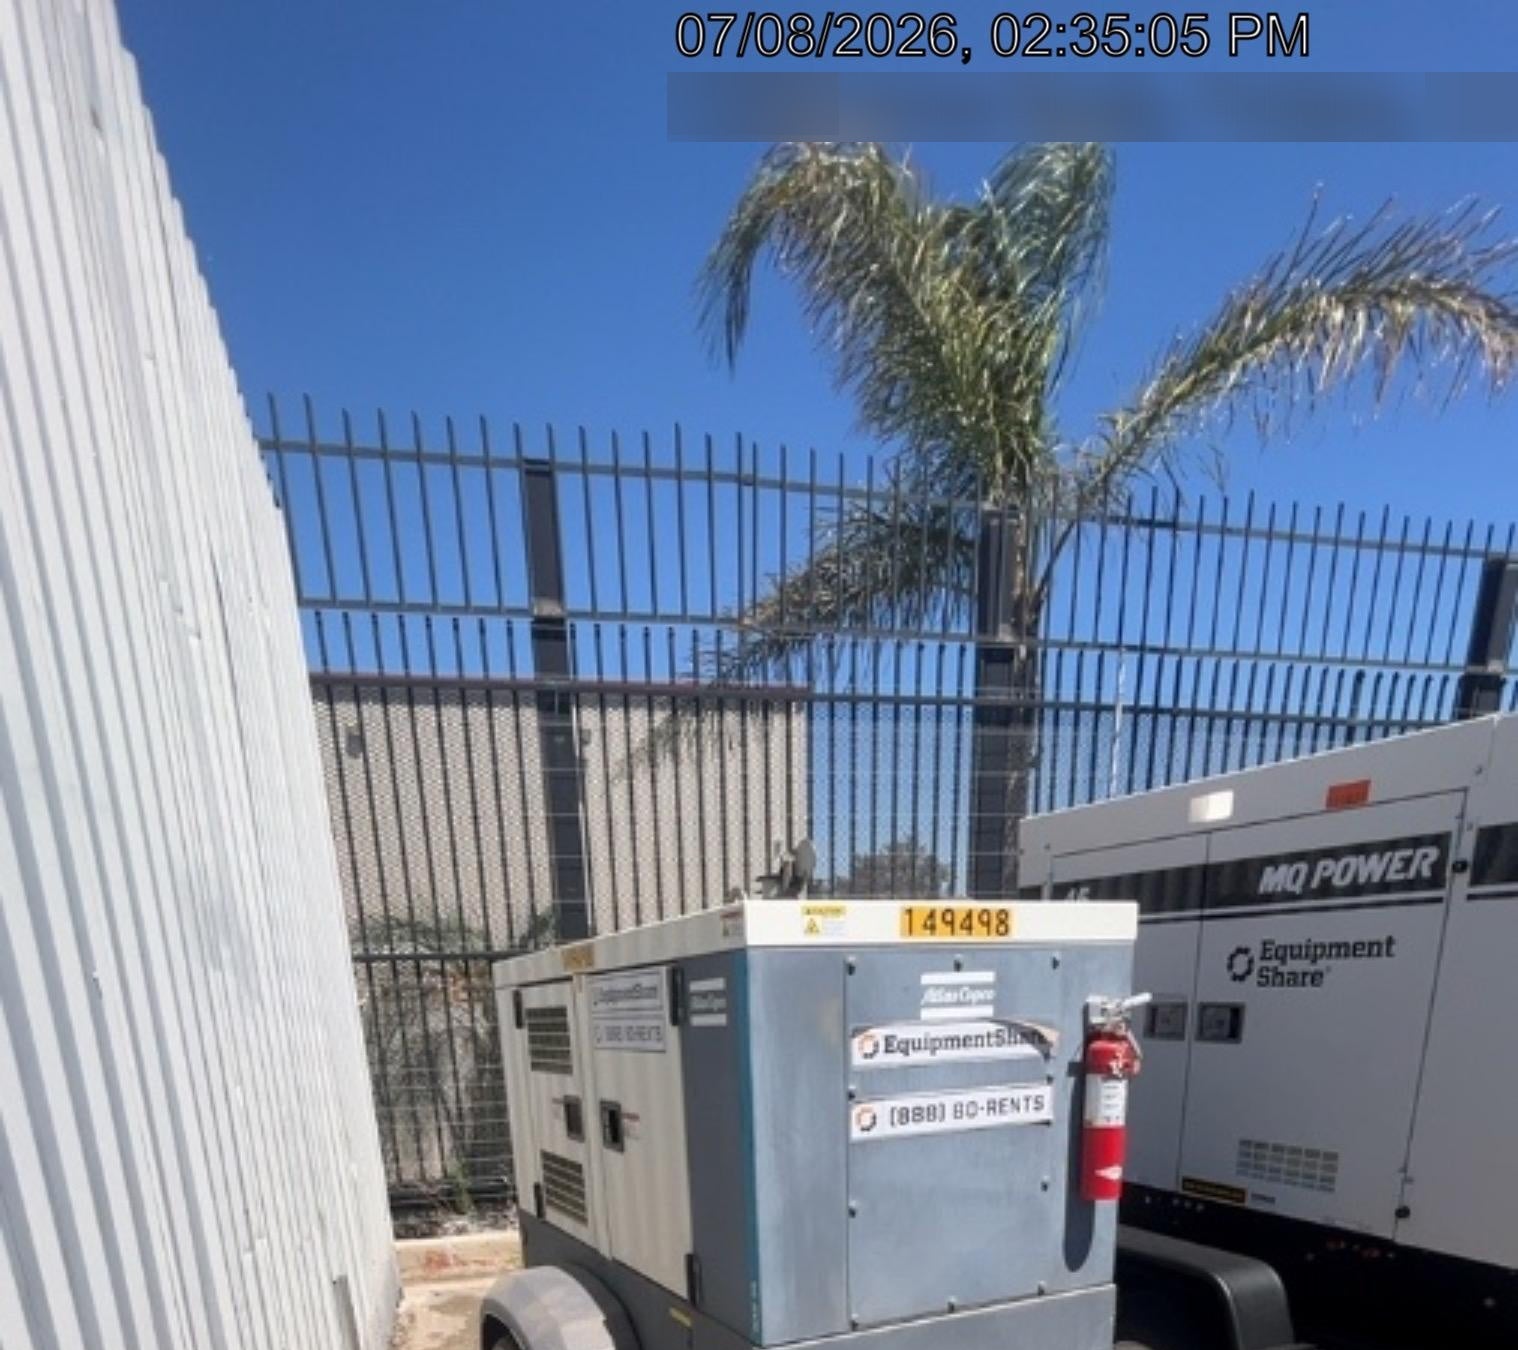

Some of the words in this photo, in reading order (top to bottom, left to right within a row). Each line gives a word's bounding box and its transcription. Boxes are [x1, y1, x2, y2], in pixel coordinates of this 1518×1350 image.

[1258, 861, 1309, 895] MQ
[1311, 846, 1441, 889] POWER
[904, 907, 1010, 937] 149498
[1259, 935, 1396, 966] Equipment
[1256, 965, 1324, 988] Share
